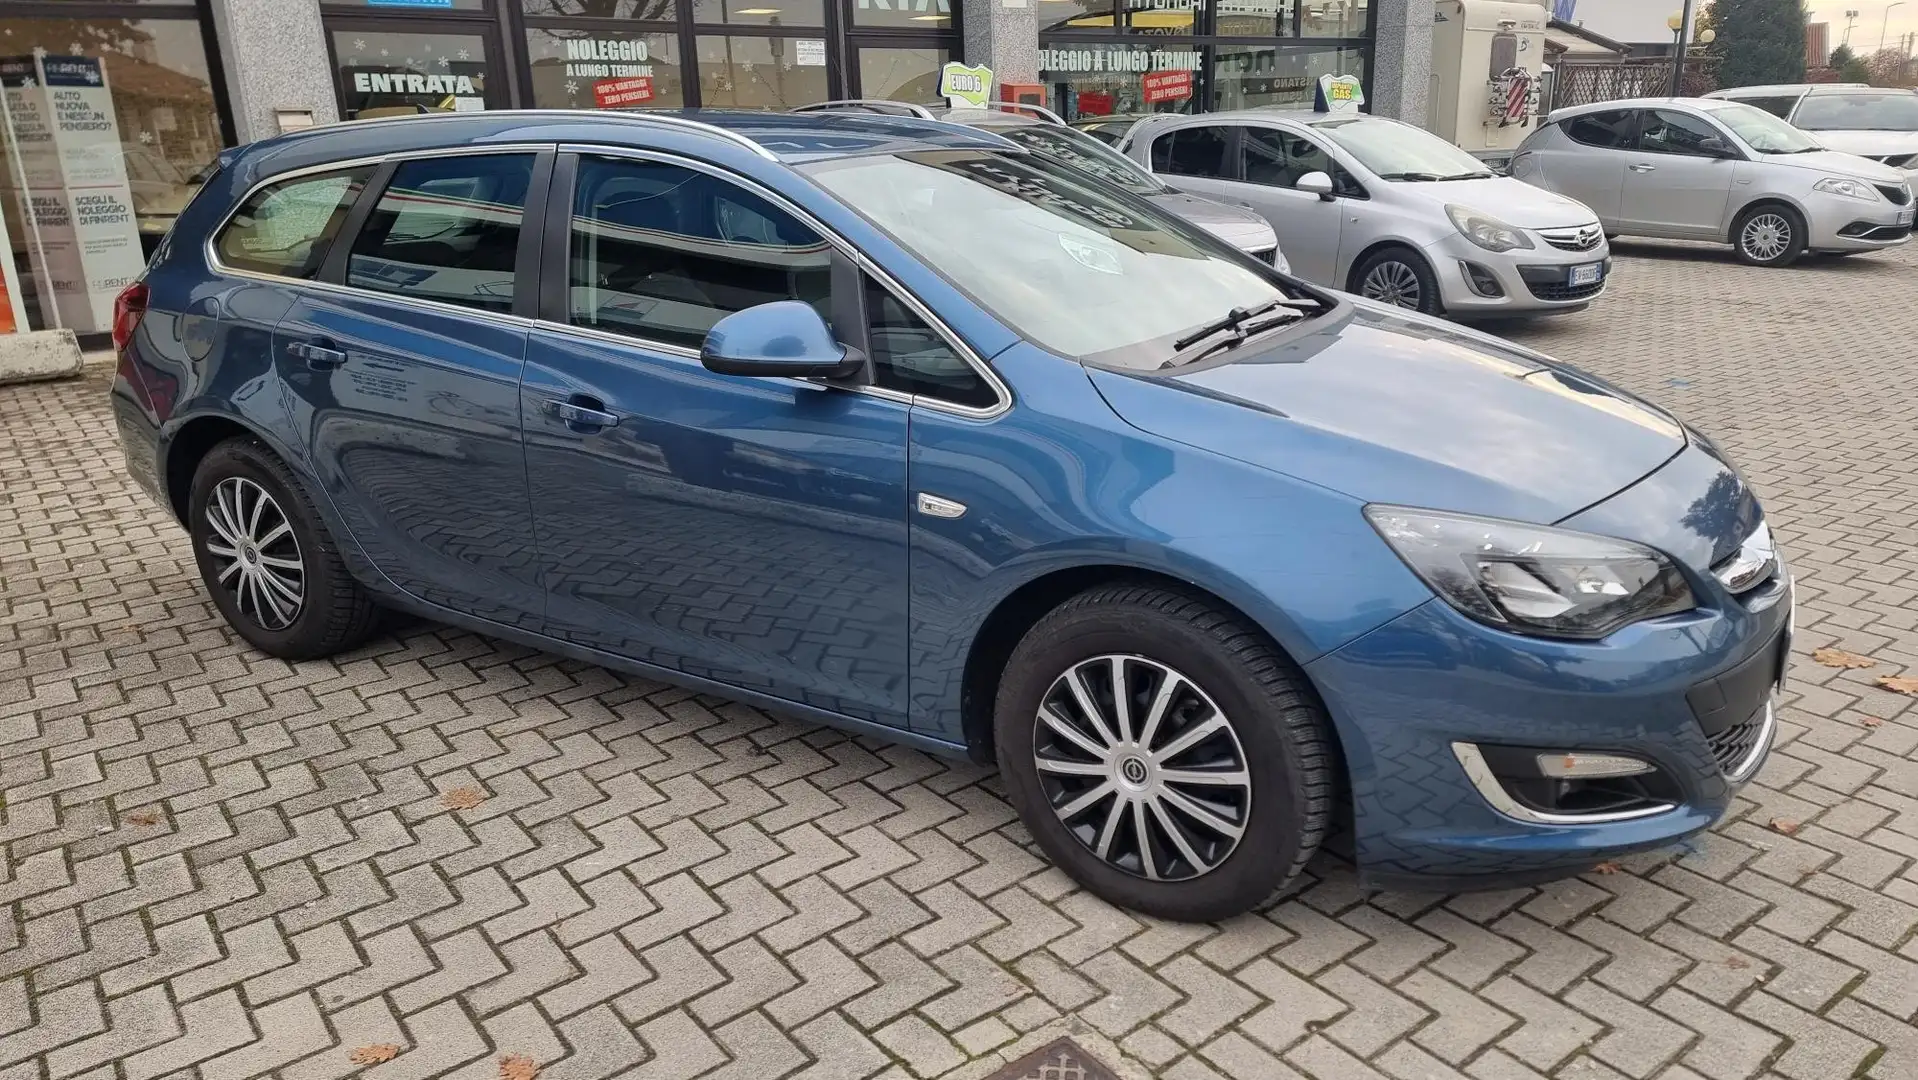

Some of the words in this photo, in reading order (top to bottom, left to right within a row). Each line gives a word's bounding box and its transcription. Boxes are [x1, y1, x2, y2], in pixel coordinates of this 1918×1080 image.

[566, 39, 648, 61] NOLEGGIO
[1038, 49, 1091, 71] OLEGGIO
[1094, 50, 1104, 71] A
[1107, 50, 1148, 71] LUNGO
[1151, 52, 1203, 71] TERMINE
[566, 64, 574, 76] A
[575, 64, 609, 77] LUNGO
[610, 64, 654, 77] TERMINE
[354, 72, 475, 94] ENTRATA
[951, 74, 973, 91] EURO
[974, 75, 982, 92] 6
[54, 91, 81, 101] AUTO
[1333, 88, 1351, 99] GAS
[75, 195, 107, 205] SCEGLI
[77, 204, 126, 215] NOLEGGIO
